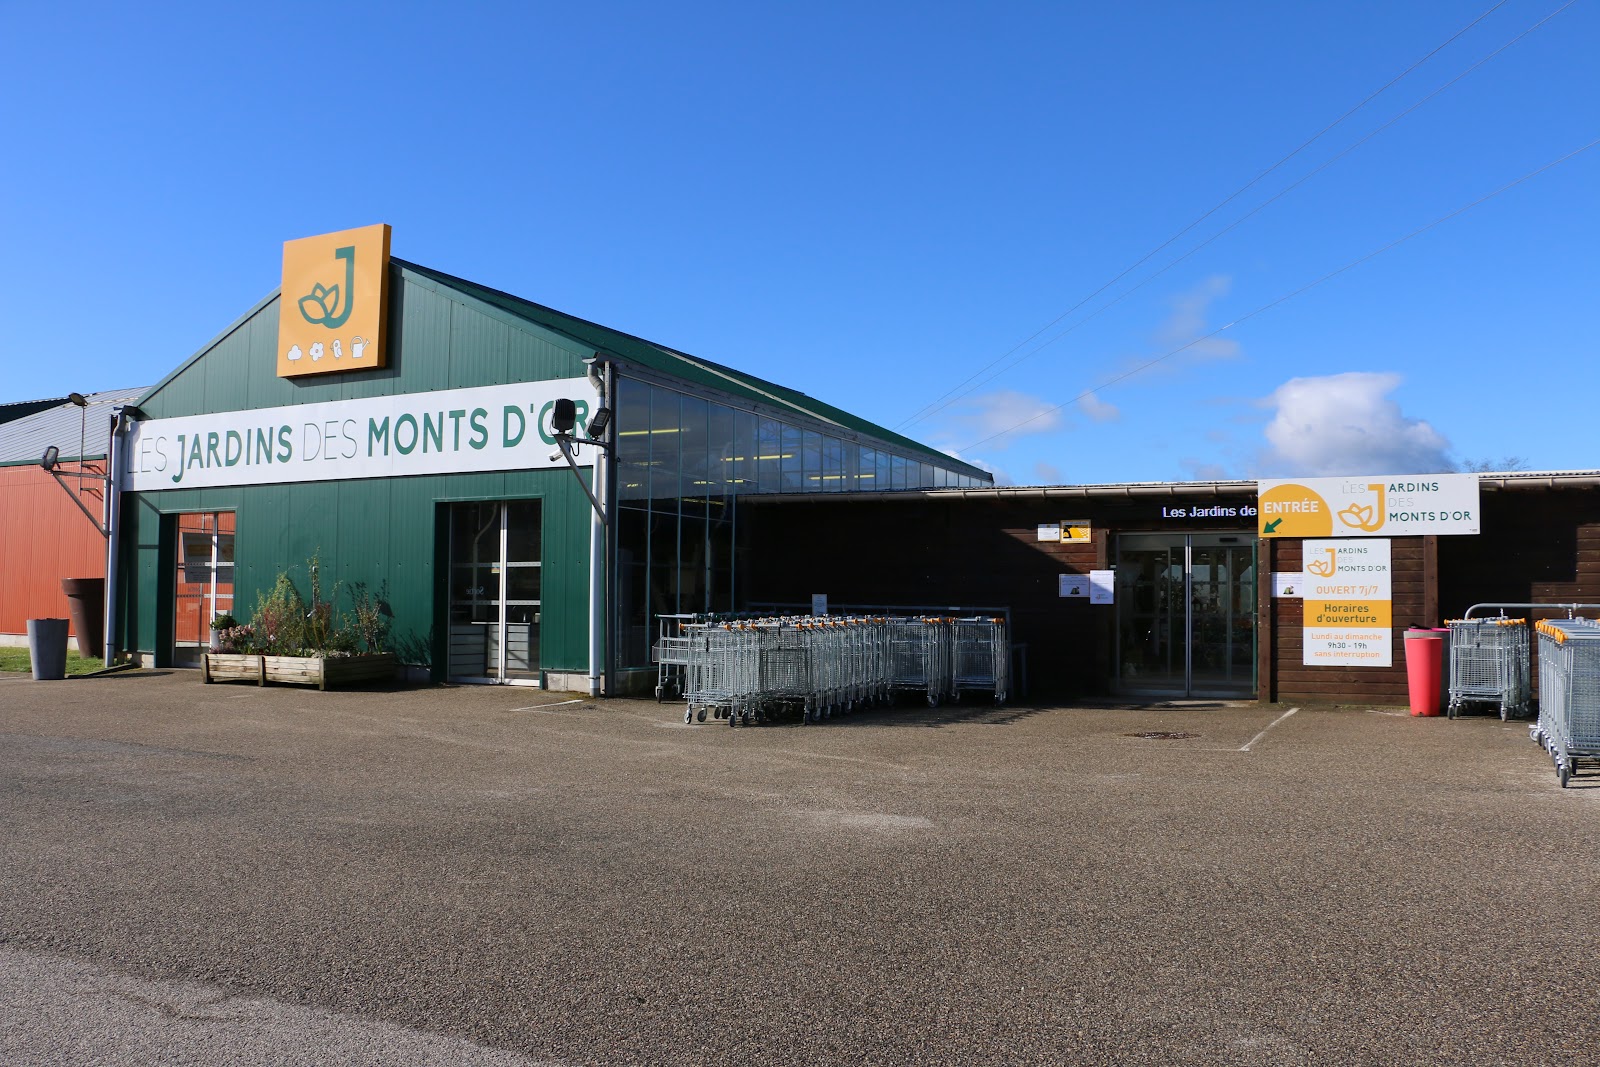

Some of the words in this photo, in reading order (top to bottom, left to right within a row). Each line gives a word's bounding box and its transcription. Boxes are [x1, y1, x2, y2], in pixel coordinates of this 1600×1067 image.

[127, 436, 168, 474] LES
[171, 424, 293, 483] JARDINS
[302, 419, 358, 462] DES
[367, 407, 489, 457] MONTS
[1263, 498, 1319, 514] ENTRÉE
[1388, 498, 1415, 508] DES
[1162, 506, 1187, 518] Les
[1189, 505, 1237, 518] Jardins
[1388, 511, 1436, 522] MONTS
[1440, 511, 1473, 521] D'OR
[1316, 585, 1357, 595] OUVERT
[1359, 585, 1379, 597] 7j/7
[1324, 603, 1369, 613] Horaires
[1316, 614, 1377, 623] d'ouverture
[1311, 632, 1333, 640] Lundi
[1345, 632, 1383, 641] dimanche
[1353, 642, 1367, 650] 19h
[1333, 651, 1380, 660] interruption
